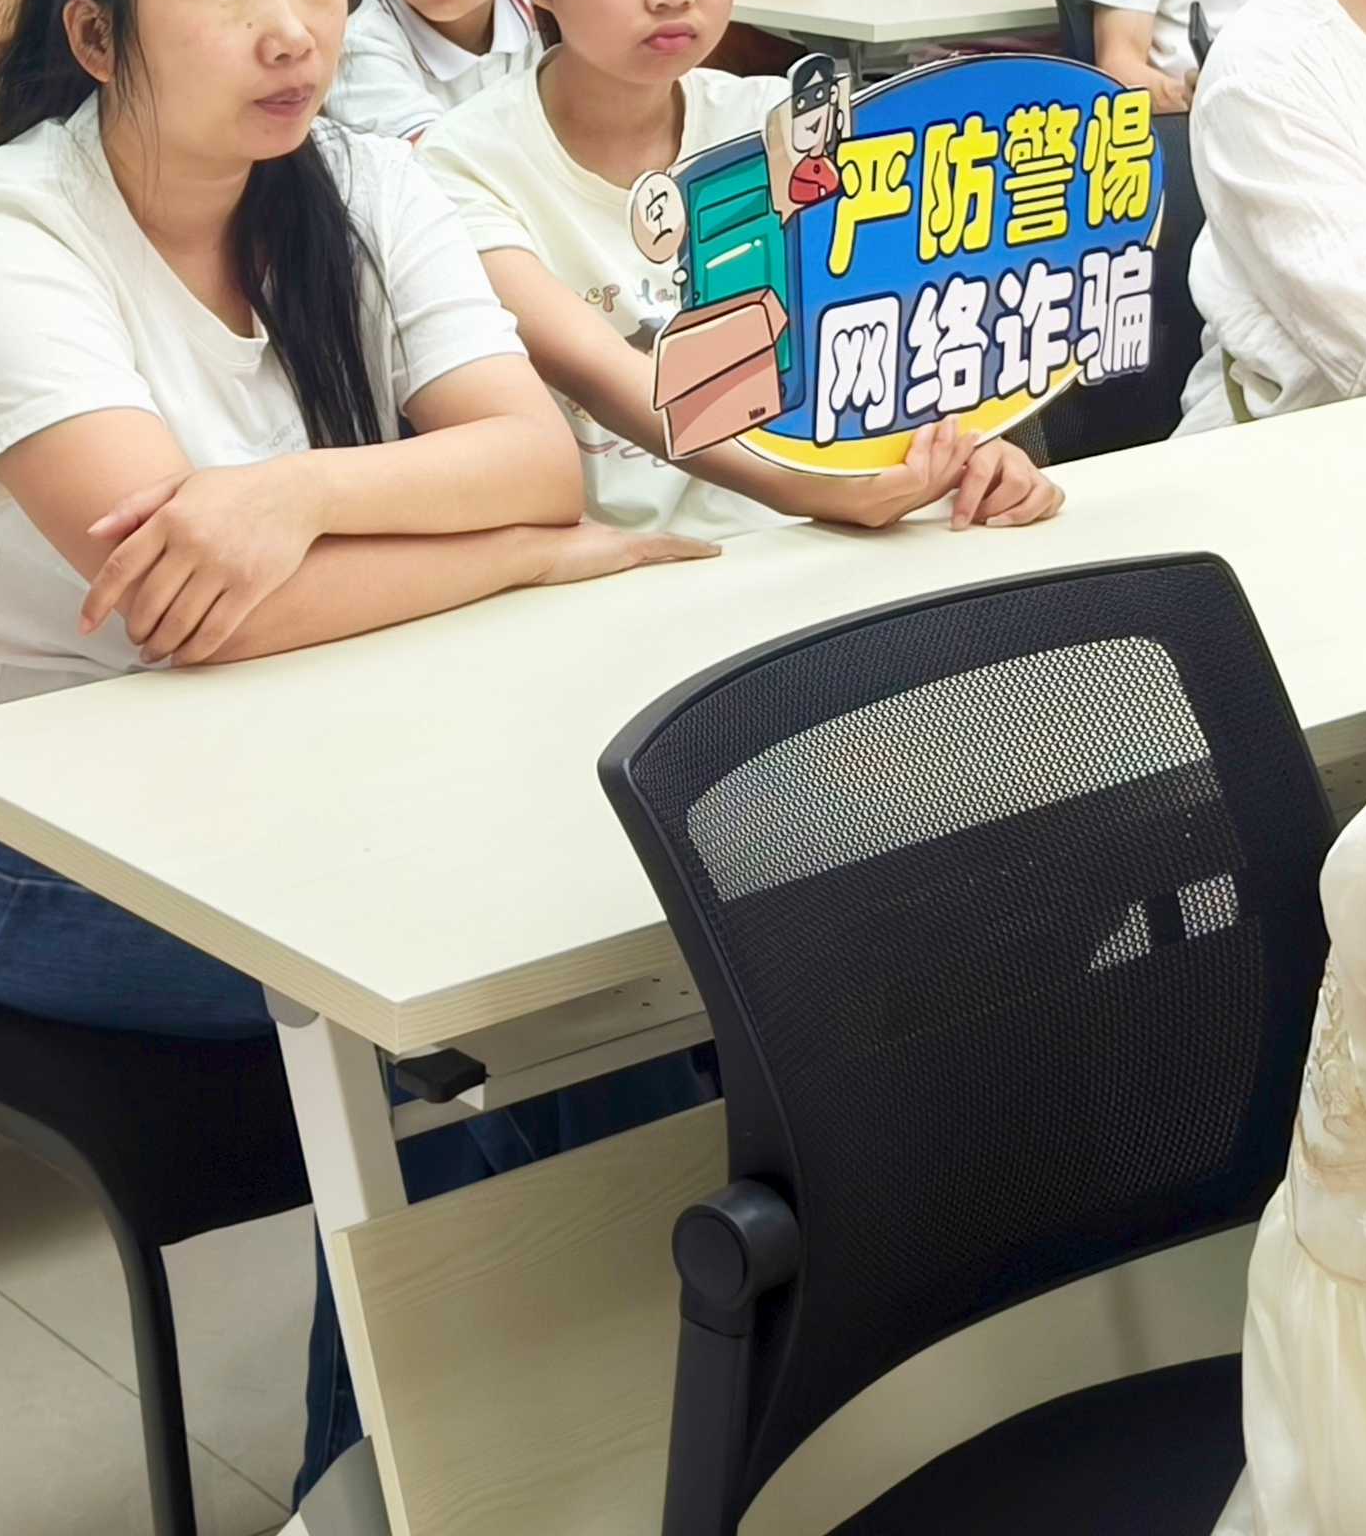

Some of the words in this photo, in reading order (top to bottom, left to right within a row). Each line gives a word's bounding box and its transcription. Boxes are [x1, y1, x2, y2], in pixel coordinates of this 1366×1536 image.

[644, 188, 673, 245] 空
[828, 89, 1154, 277] 严防警惕
[813, 245, 1154, 447] 网络诈骗
